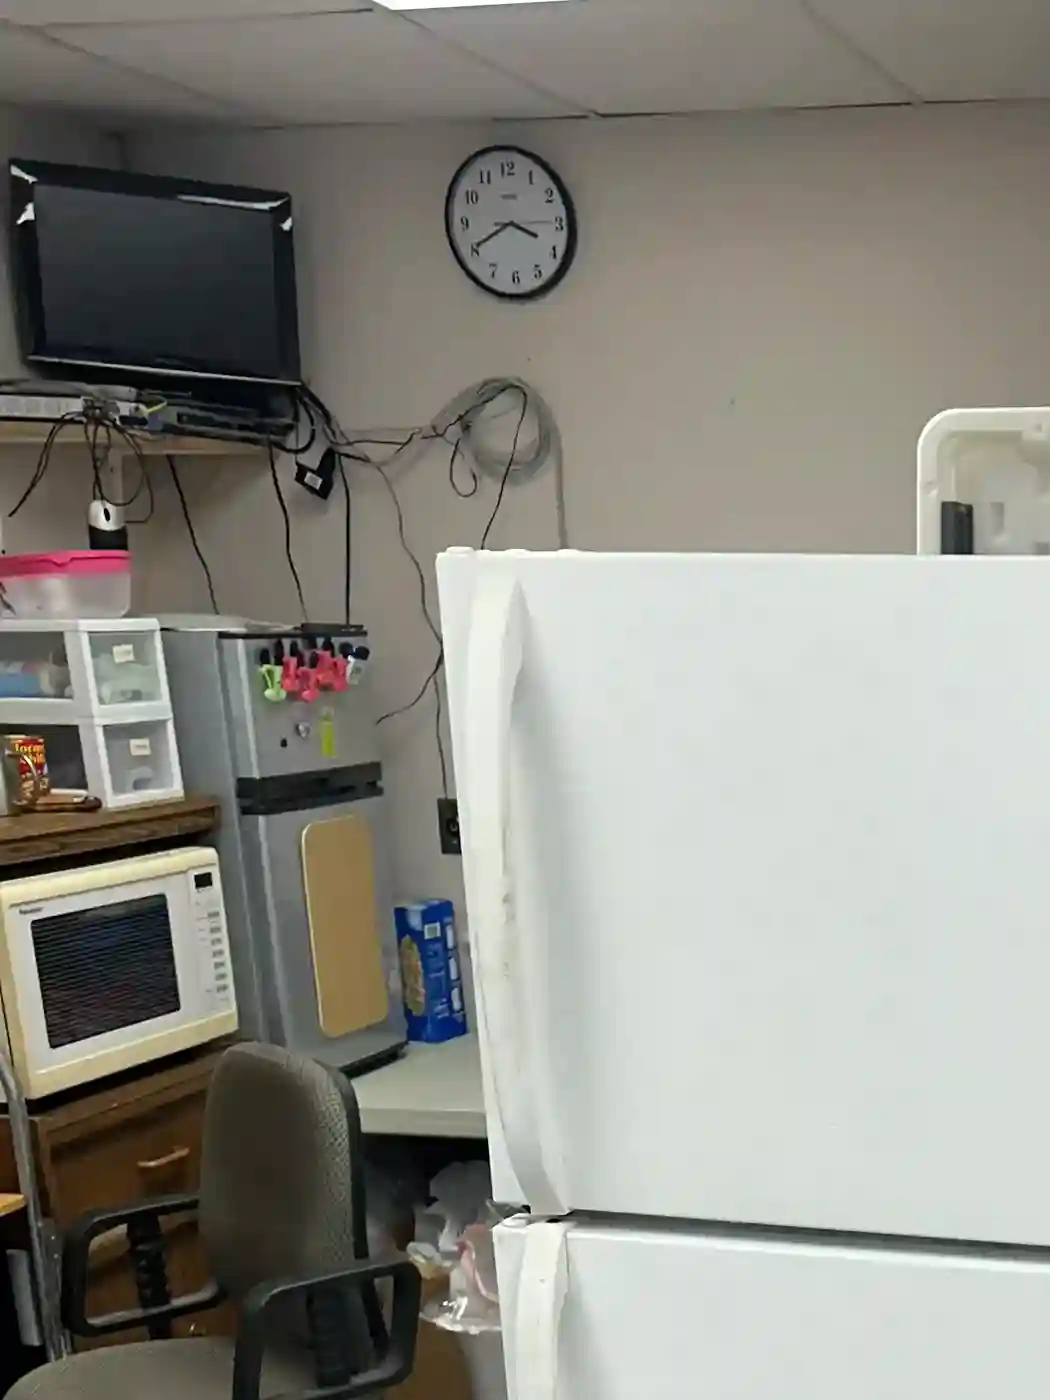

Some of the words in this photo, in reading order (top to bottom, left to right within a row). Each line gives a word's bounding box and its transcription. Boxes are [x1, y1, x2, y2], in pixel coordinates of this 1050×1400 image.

[479, 169, 492, 185] 11
[500, 160, 516, 178] 12
[528, 169, 534, 185] 1
[465, 188, 479, 205] 10
[544, 187, 555, 204] 2
[460, 215, 470, 232] 9
[554, 216, 564, 232] 3
[470, 243, 480, 258] 8
[489, 263, 497, 279] 7
[511, 269, 521, 285] 6
[533, 264, 543, 279] 5
